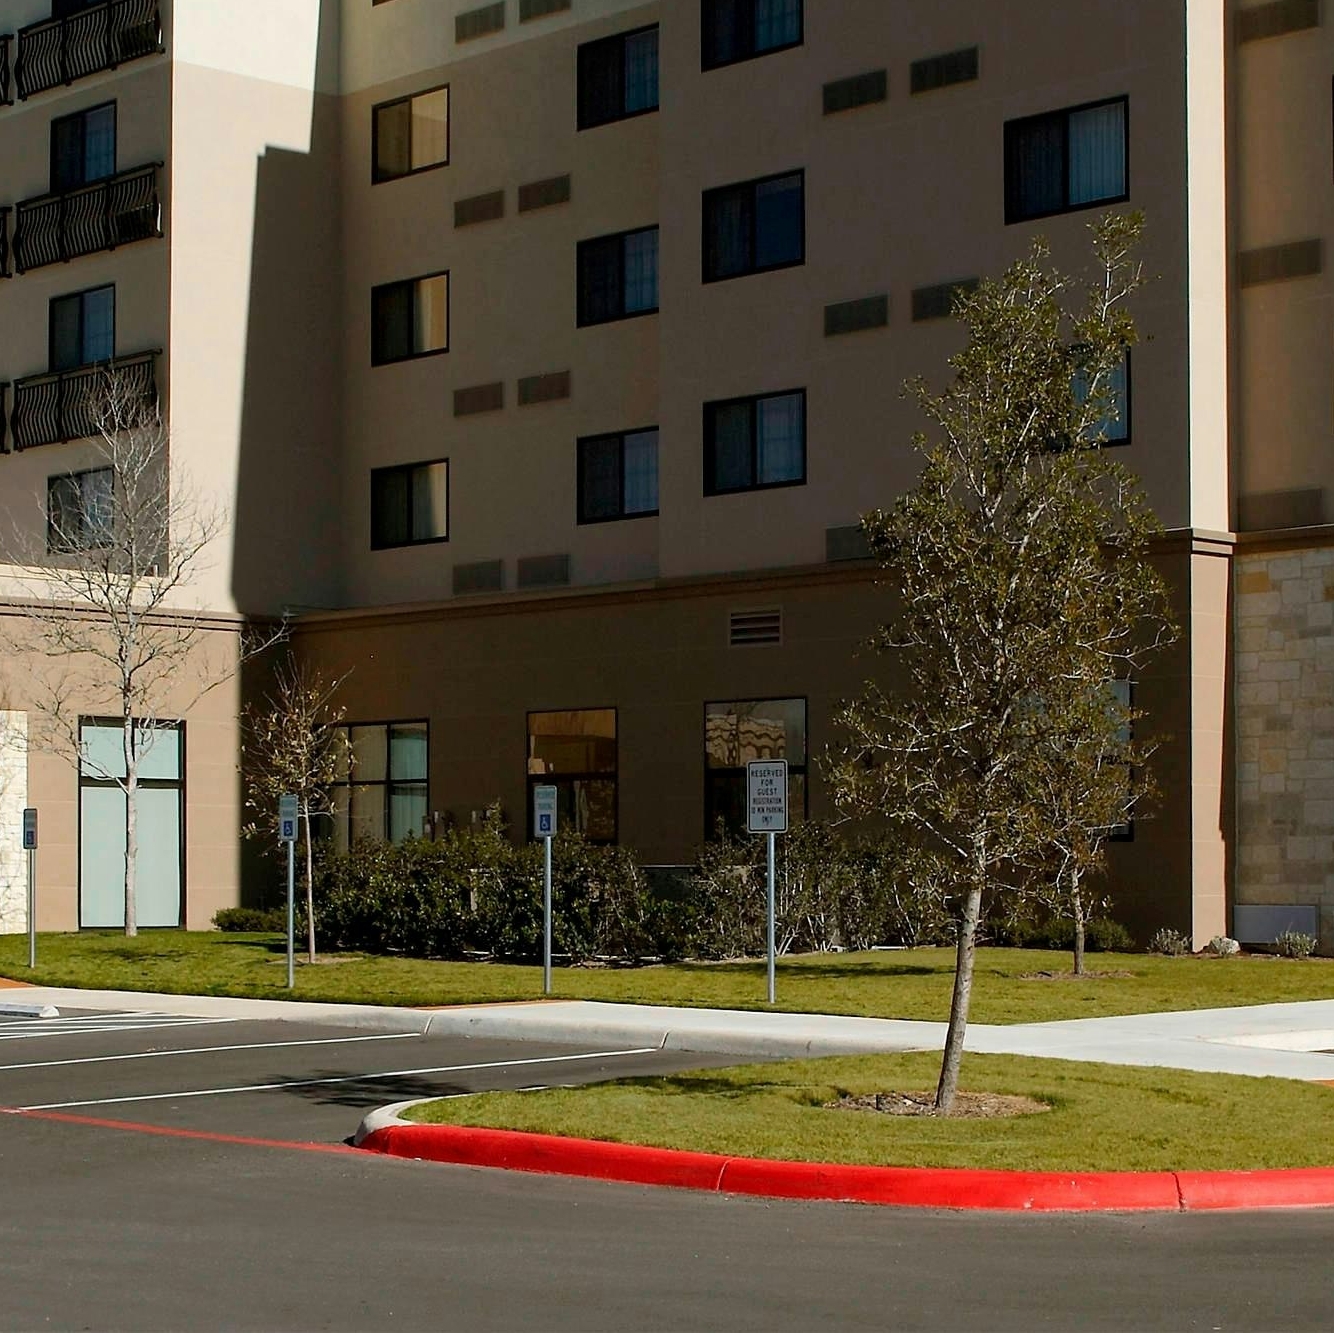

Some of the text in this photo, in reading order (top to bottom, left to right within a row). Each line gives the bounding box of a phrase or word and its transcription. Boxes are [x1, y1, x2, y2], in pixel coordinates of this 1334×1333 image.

[751, 769, 783, 778] RESERVED
[761, 778, 773, 786] FOR
[757, 787, 777, 796] GUEST
